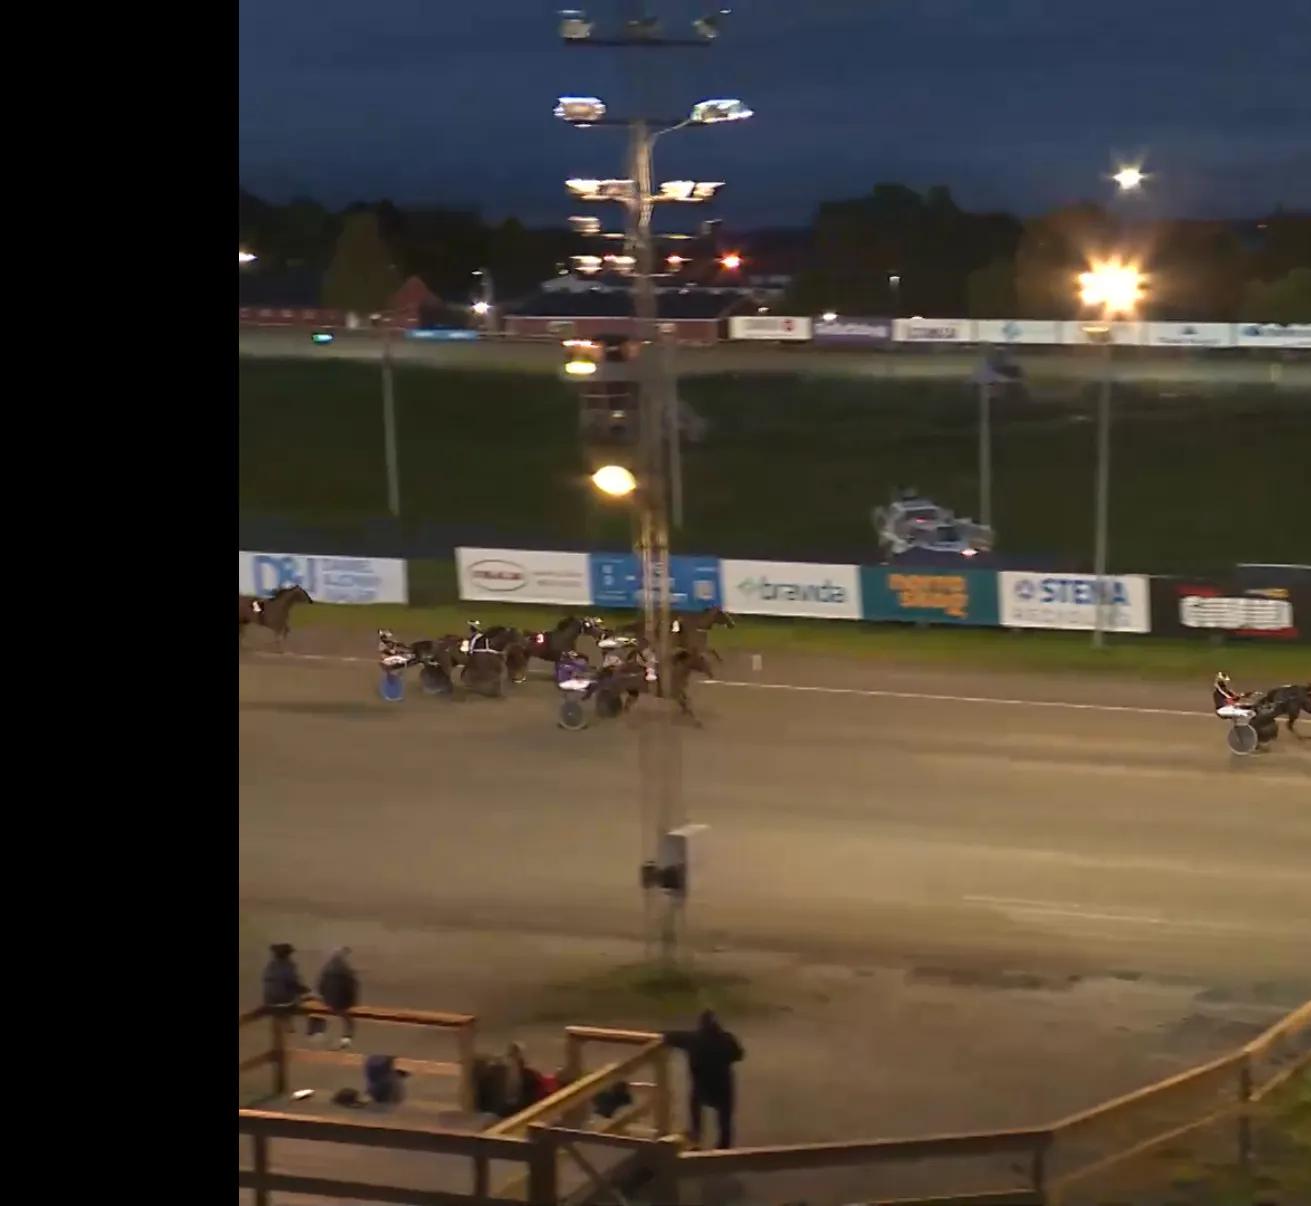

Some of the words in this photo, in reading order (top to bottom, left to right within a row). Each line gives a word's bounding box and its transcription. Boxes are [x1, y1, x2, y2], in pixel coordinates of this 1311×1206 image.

[761, 577, 846, 604] bravida
[1040, 578, 1131, 606] STENA
[1012, 607, 1131, 627] RECYCLNG
